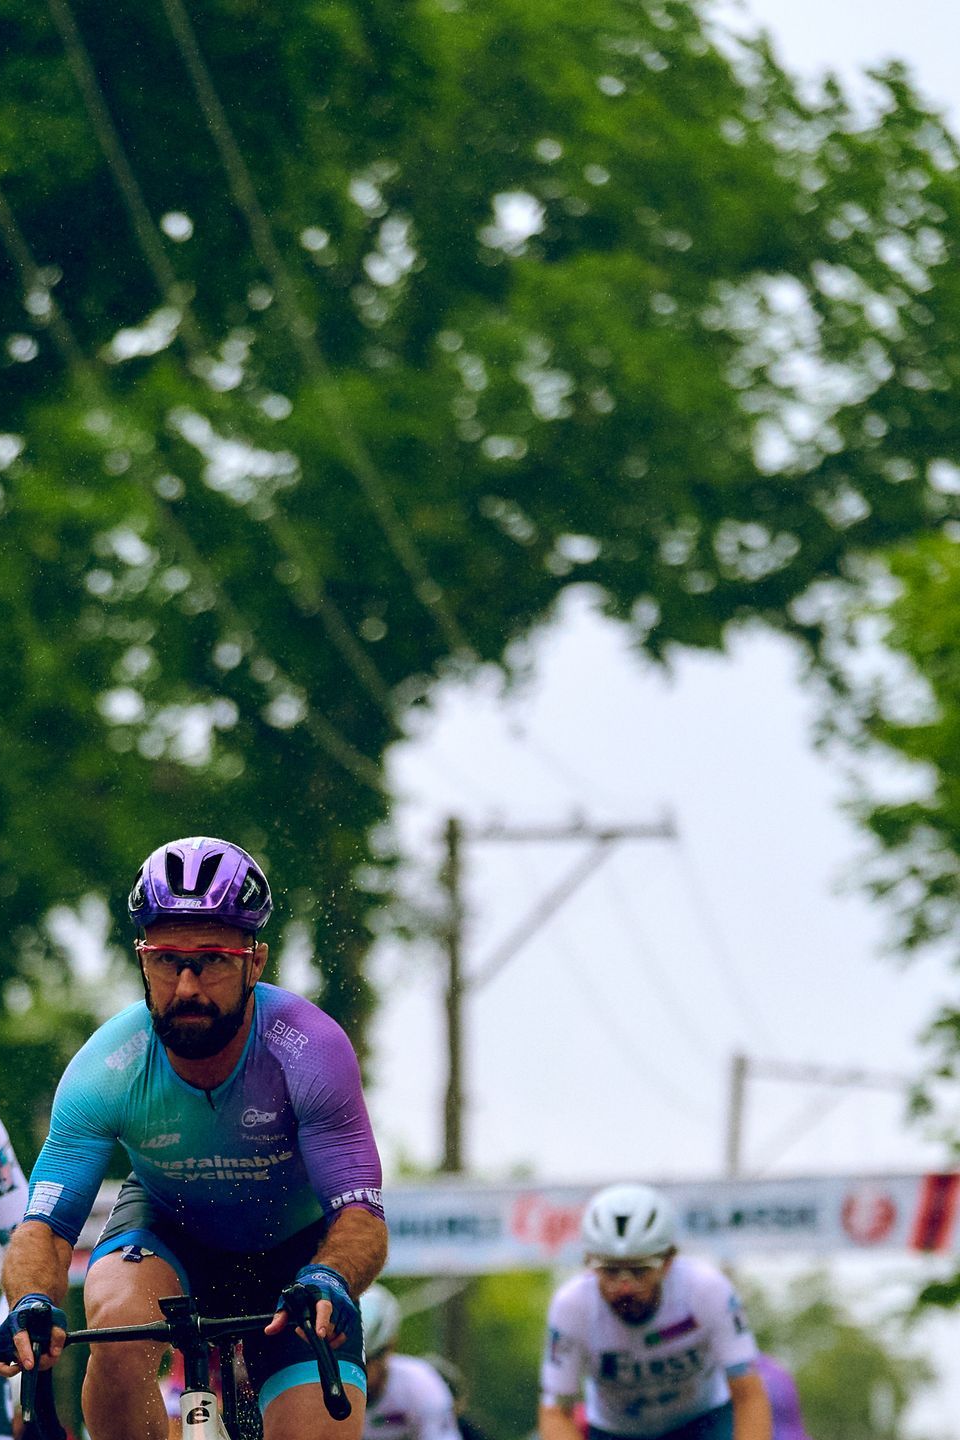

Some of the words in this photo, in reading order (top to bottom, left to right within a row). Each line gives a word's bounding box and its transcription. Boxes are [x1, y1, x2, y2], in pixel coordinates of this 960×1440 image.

[264, 1030, 303, 1060] BREWERY
[272, 1019, 309, 1050] BIER
[163, 1170, 271, 1181] Cycling
